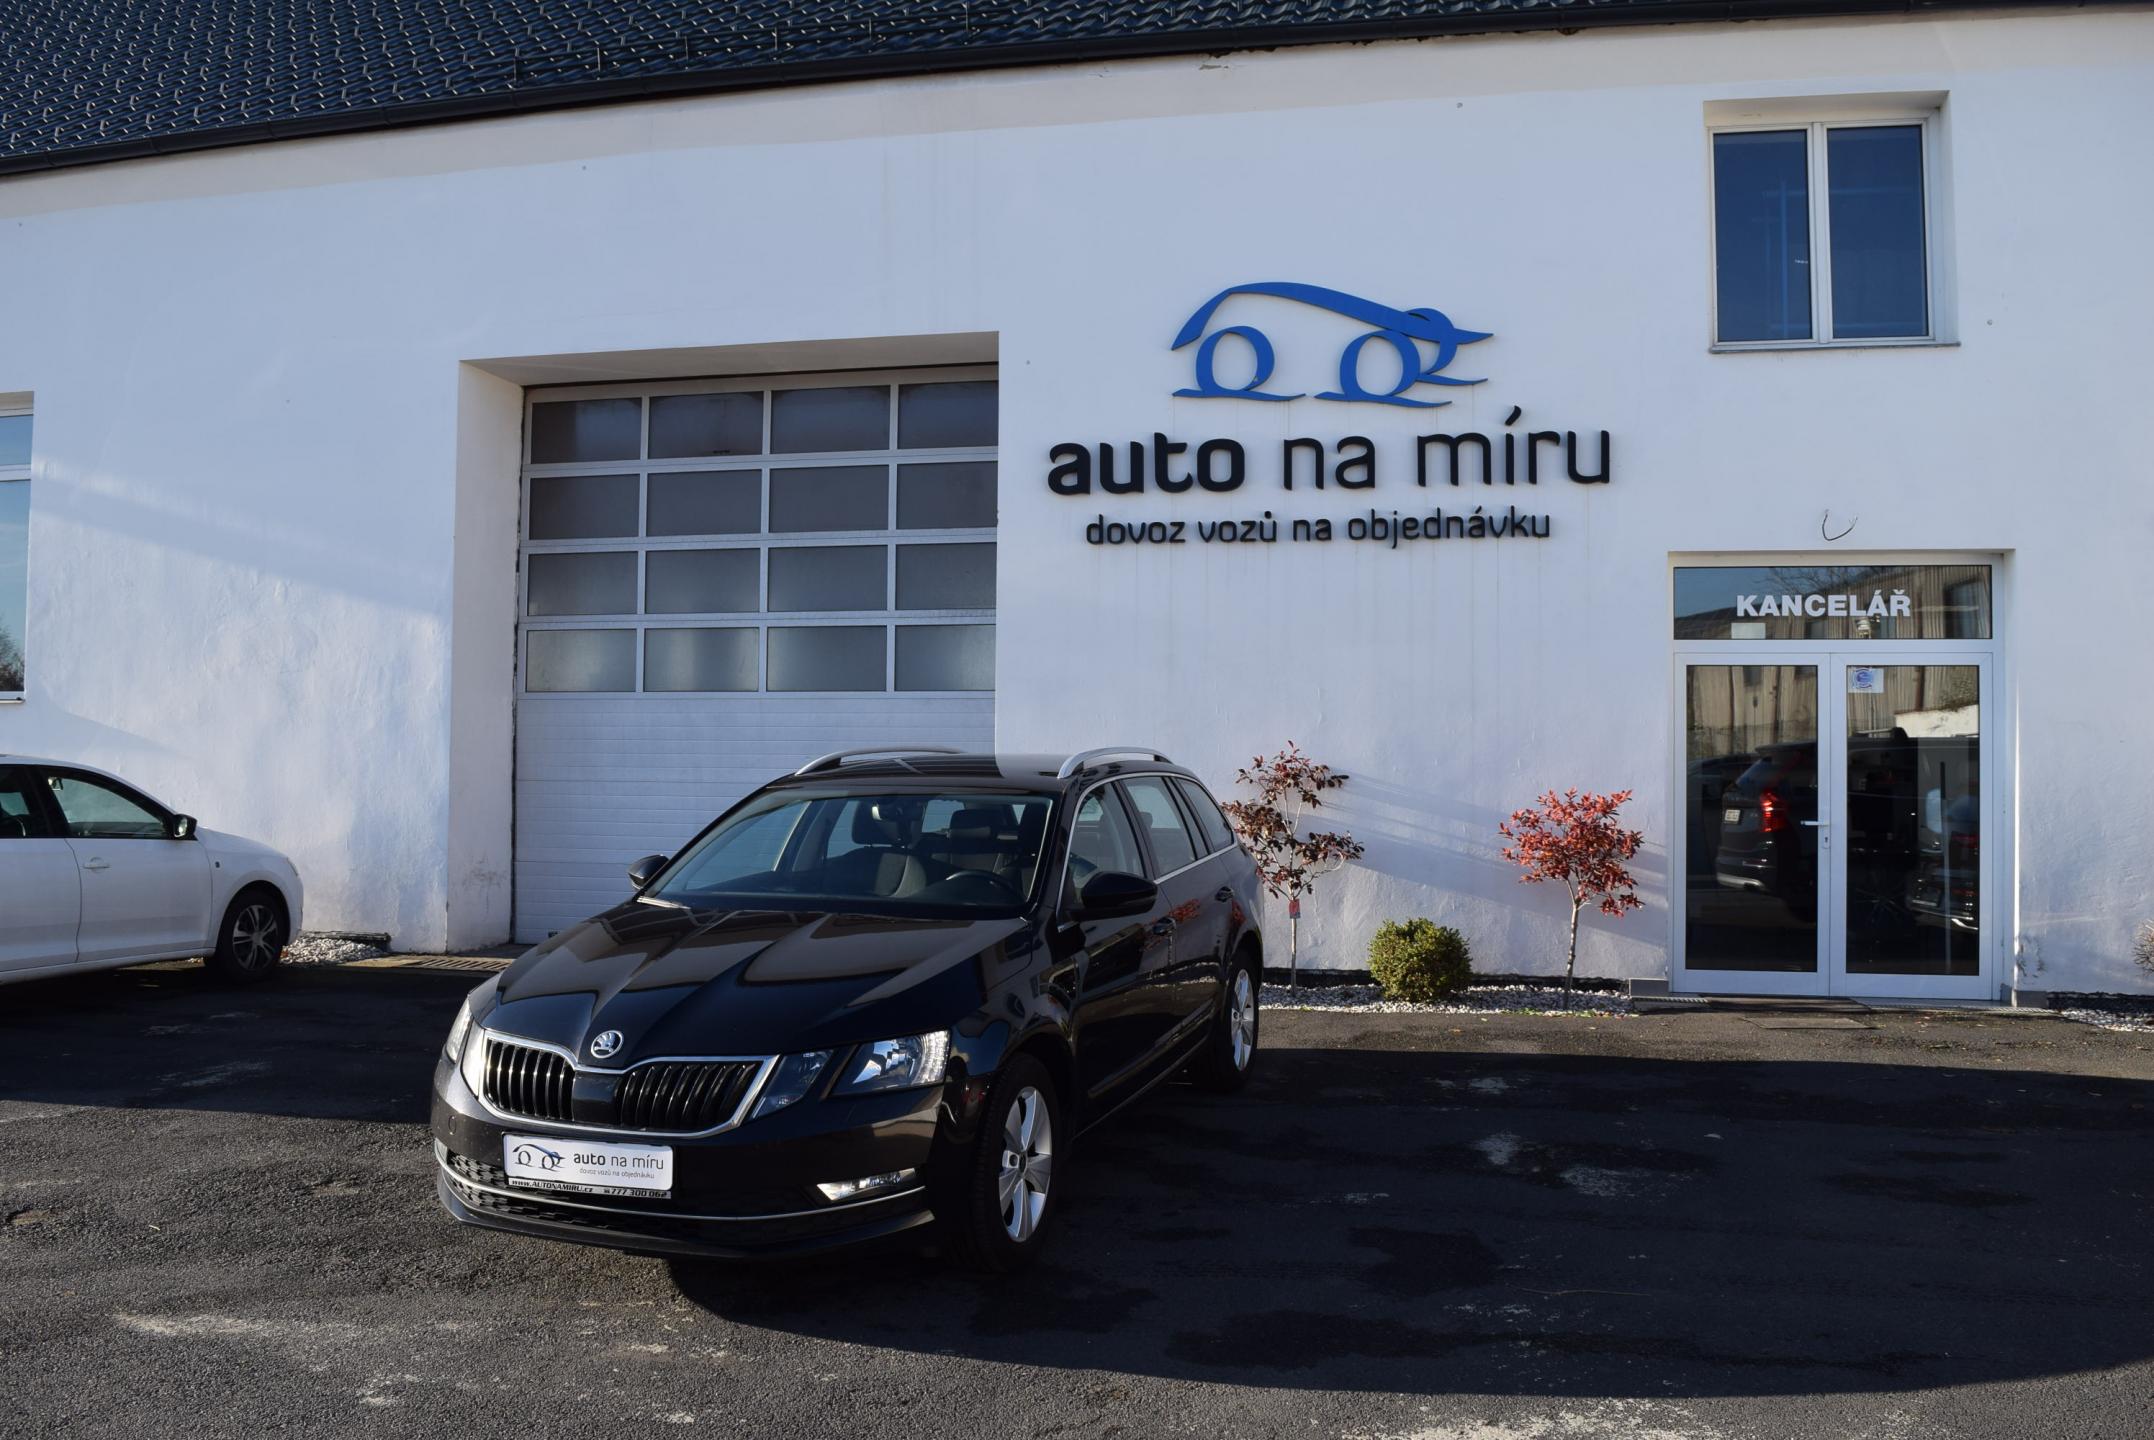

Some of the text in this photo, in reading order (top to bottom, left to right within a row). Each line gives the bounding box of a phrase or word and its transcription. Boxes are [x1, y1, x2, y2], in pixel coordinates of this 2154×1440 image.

[1047, 405, 1611, 497] auto na míru
[1085, 505, 1551, 550] dovoz vozů na objednávku
[1736, 589, 1911, 617] KANCELÁŘ
[573, 1152, 664, 1170] auto na míru
[511, 1179, 594, 1194] www.AUTONAMIRU.cz
